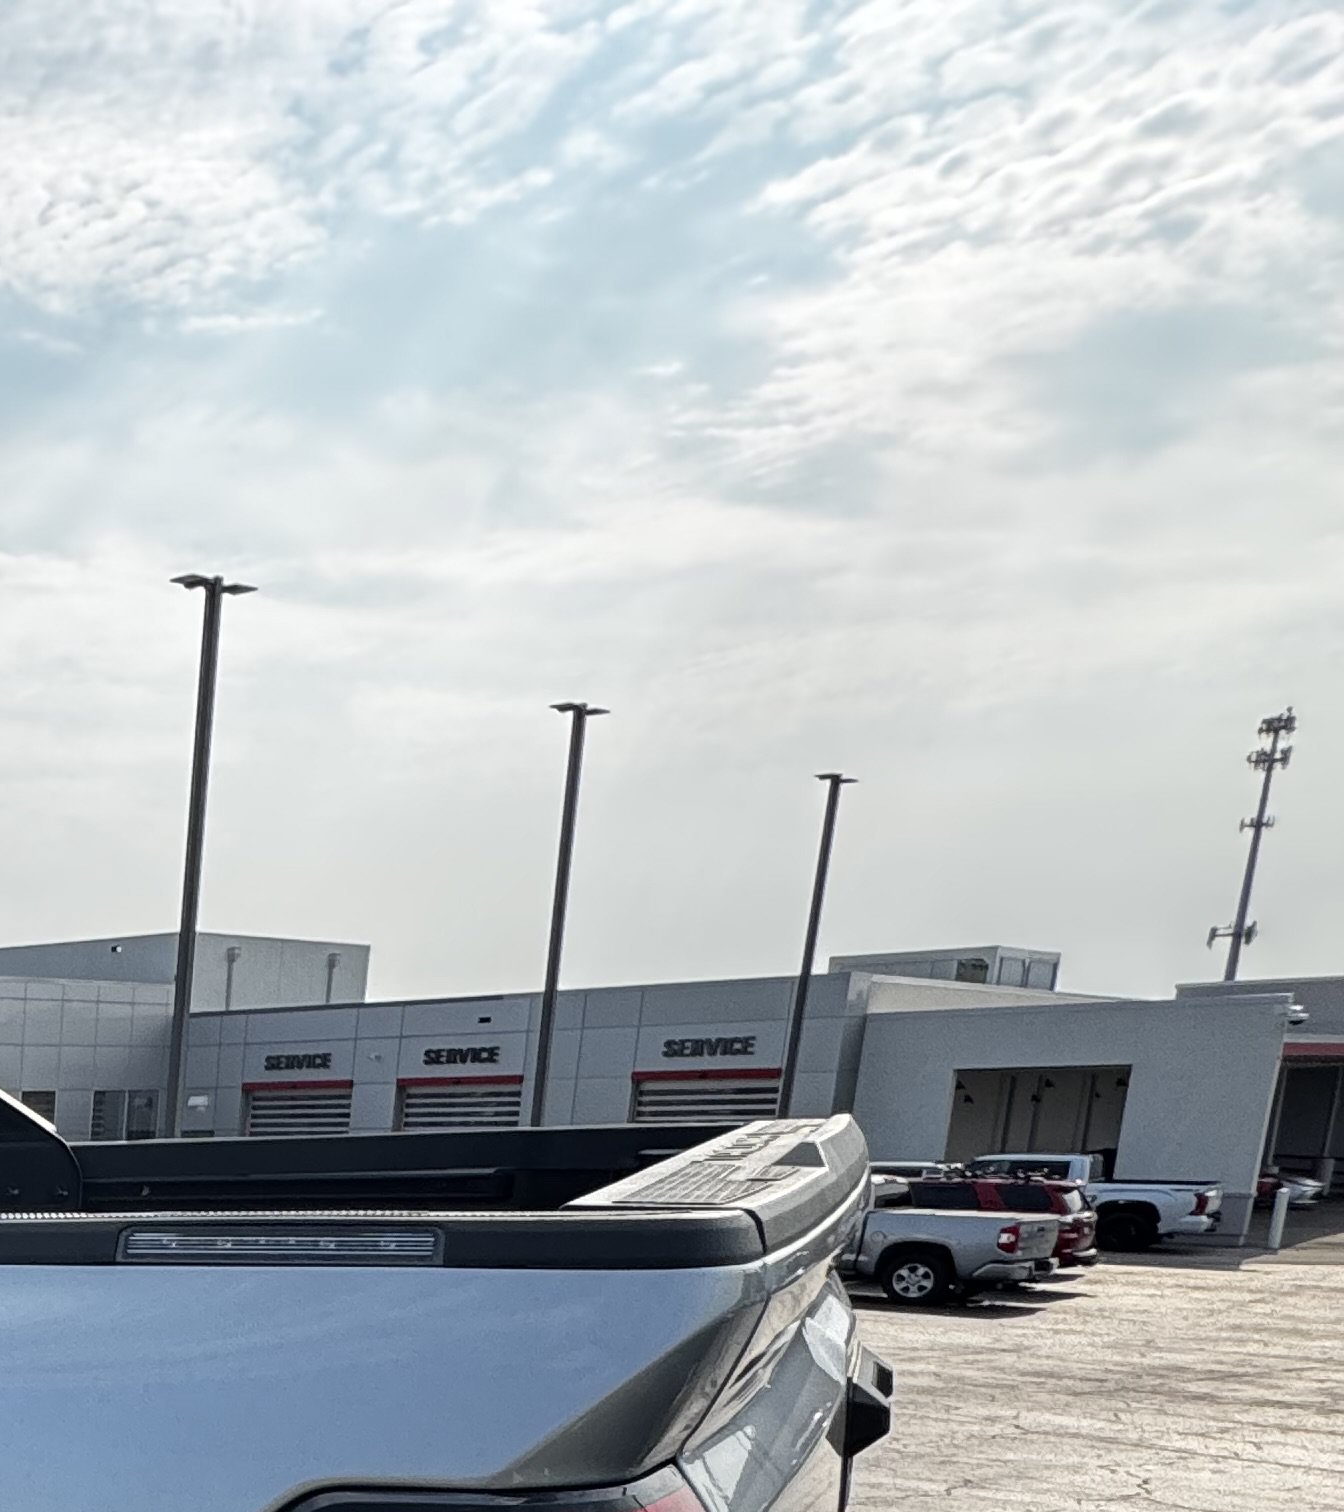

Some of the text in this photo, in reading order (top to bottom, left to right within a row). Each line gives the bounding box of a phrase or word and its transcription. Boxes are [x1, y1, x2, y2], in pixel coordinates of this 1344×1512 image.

[422, 1046, 500, 1066] SERVICE
[662, 1036, 756, 1058] SERVICE
[264, 1053, 332, 1071] SERVICE
